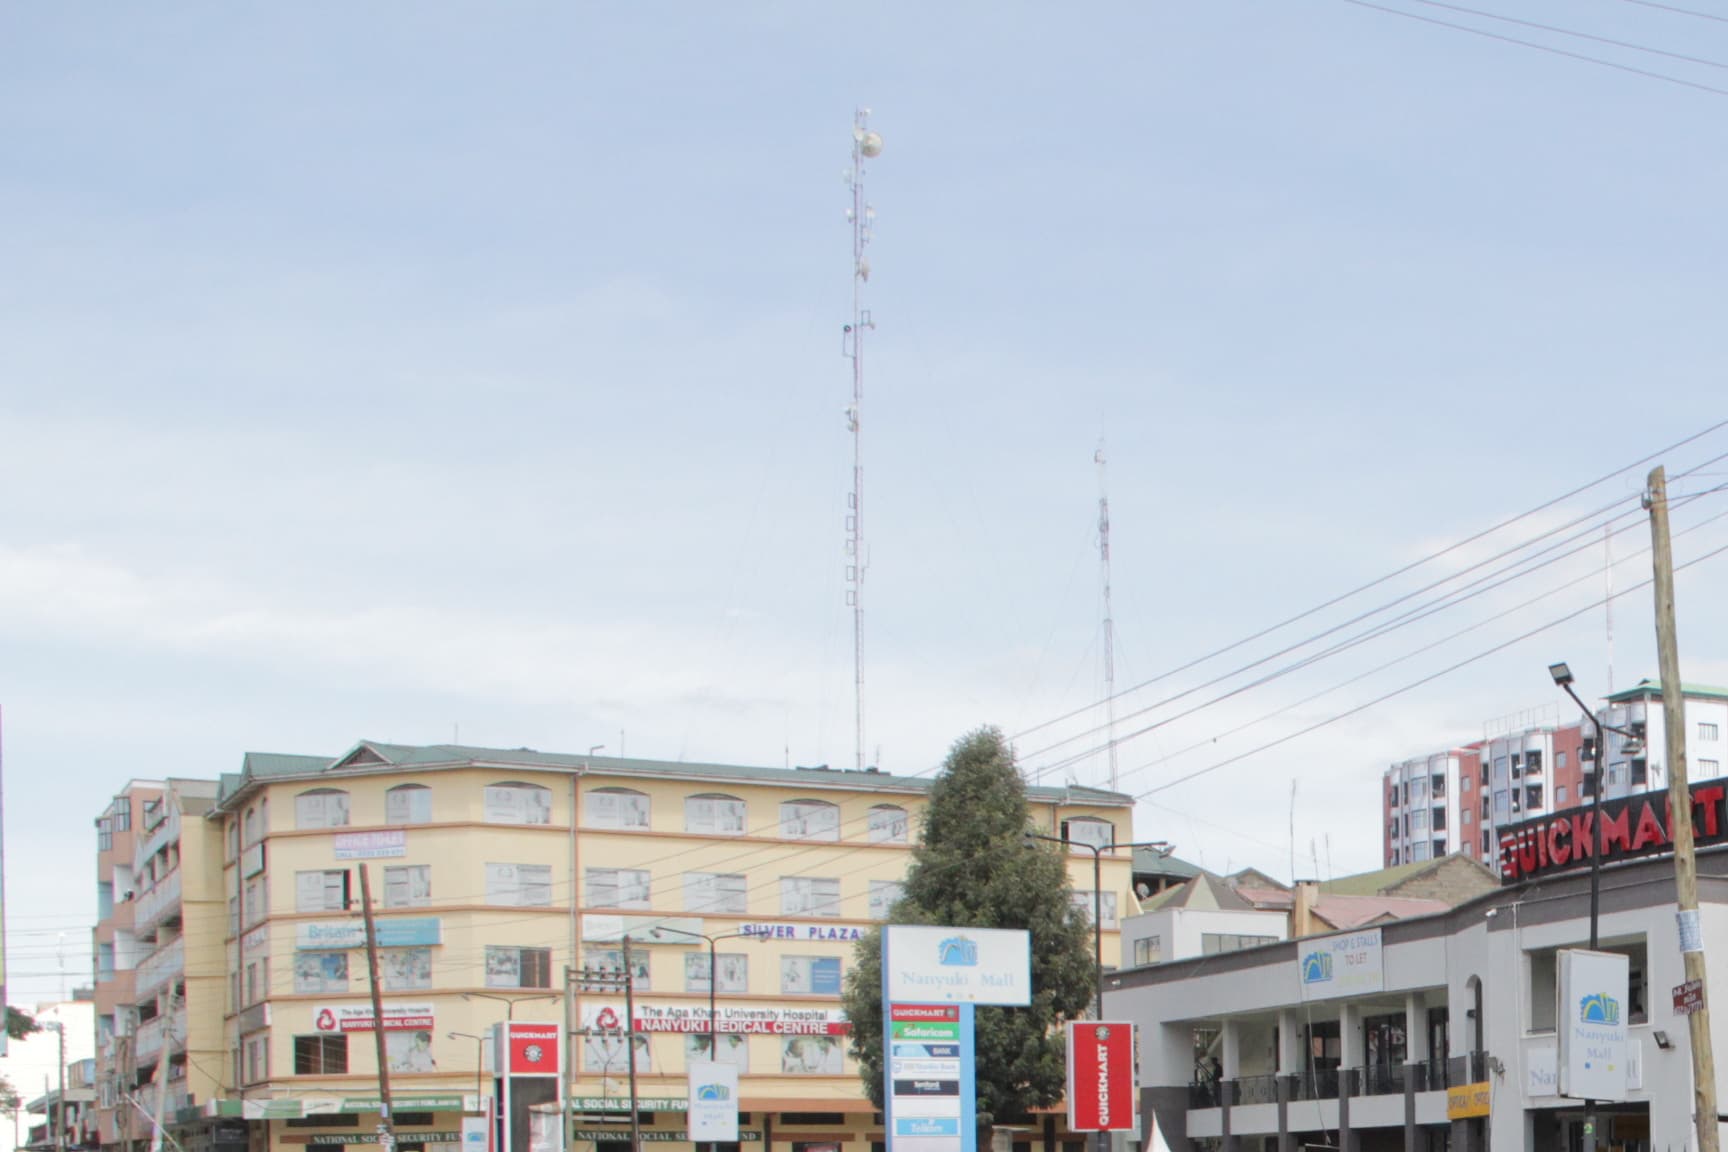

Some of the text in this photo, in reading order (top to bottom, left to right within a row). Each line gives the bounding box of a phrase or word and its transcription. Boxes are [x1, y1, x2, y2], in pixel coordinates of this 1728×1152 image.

[743, 924, 860, 940] SILVER PLAZA
[901, 971, 1014, 988] Nanyuki Mall
[642, 1006, 828, 1022] The Aga Khan University Hospital
[893, 1008, 945, 1017] QUICKMART
[641, 1019, 705, 1032] NANYUKI
[773, 1021, 828, 1034] CENTRE
[904, 1026, 953, 1037] Safaricom
[510, 1031, 557, 1039] QUICKMART
[1576, 1028, 1624, 1044] Nanyuki
[1587, 1047, 1612, 1059] Mall
[1097, 1043, 1109, 1126] QUICKMART
[583, 1099, 620, 1109] SOCIAL
[671, 1100, 688, 1109] FUN
[313, 1135, 358, 1145] NATIONAL
[397, 1132, 441, 1143] SECURITY
[578, 1131, 631, 1140] NATIONAL
[640, 1132, 673, 1141] OCIAL
